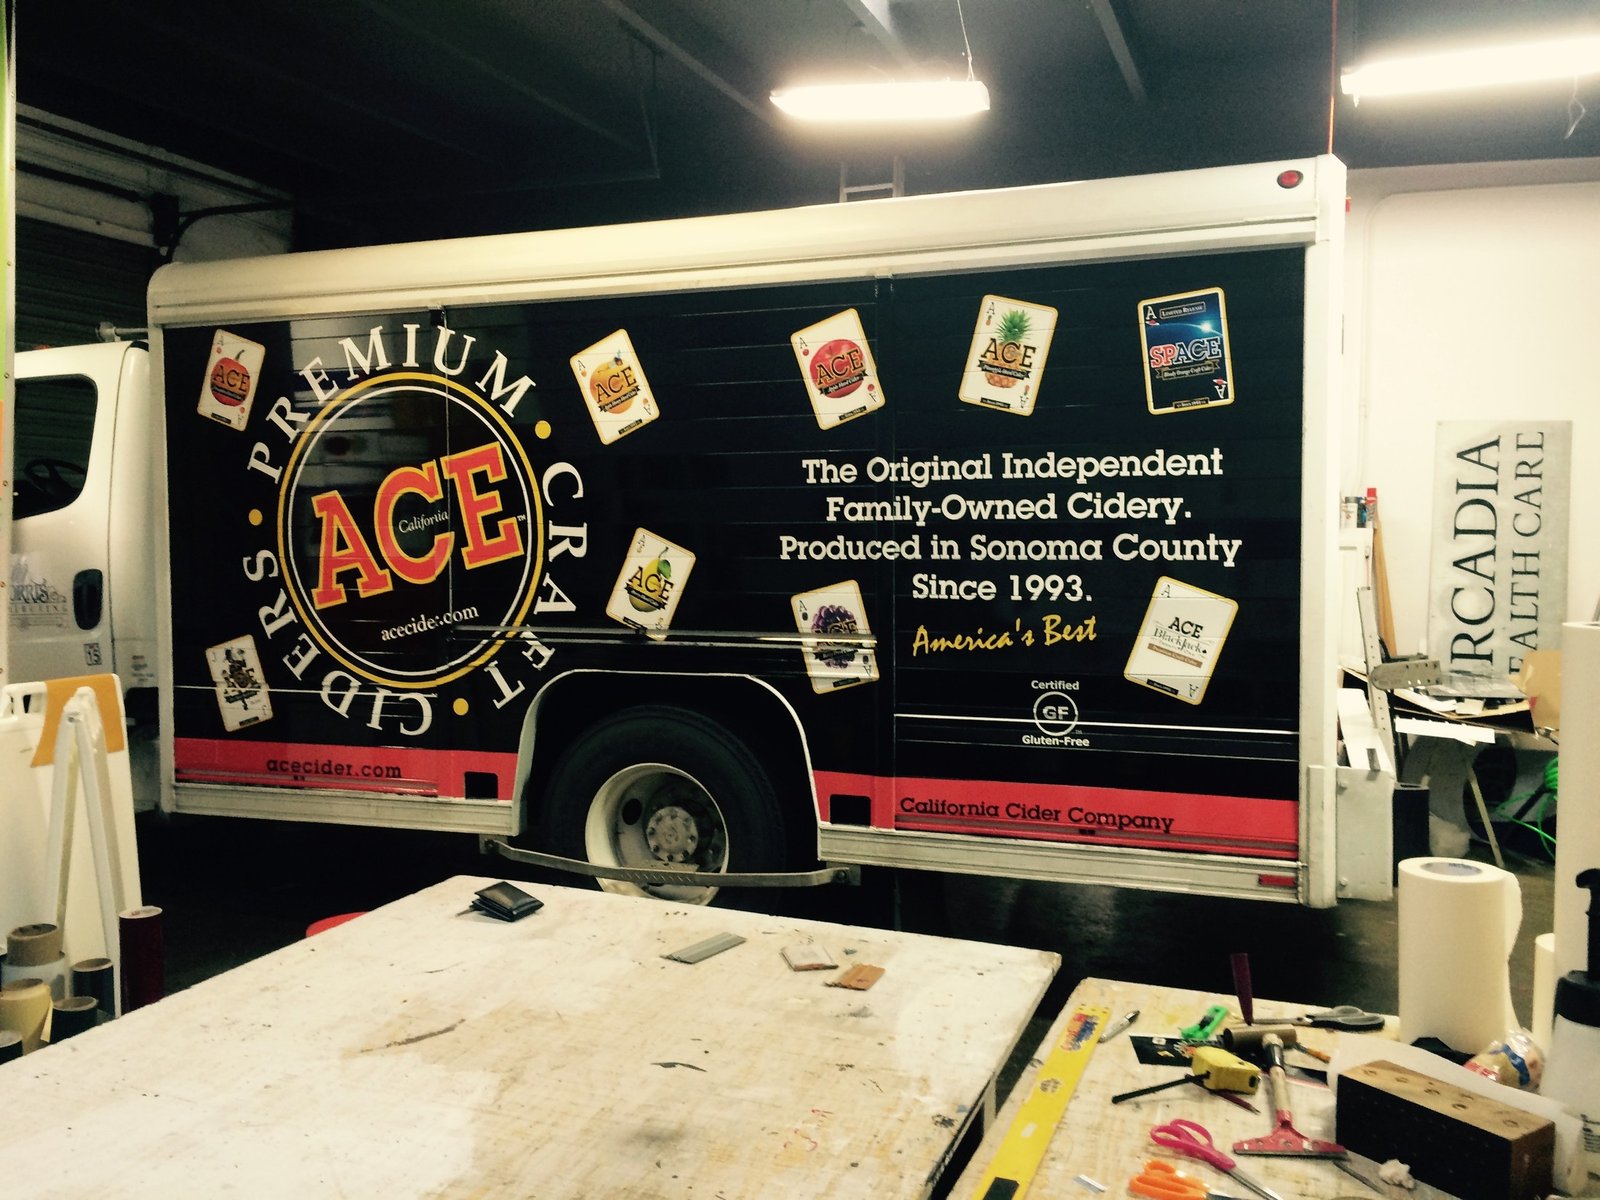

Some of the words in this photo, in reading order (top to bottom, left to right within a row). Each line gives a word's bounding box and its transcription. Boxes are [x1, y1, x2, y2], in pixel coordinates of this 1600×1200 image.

[1146, 306, 1157, 320] A
[817, 349, 864, 386] ACE
[980, 338, 1037, 369] ACE
[1150, 336, 1222, 368] SPACE
[212, 365, 250, 393] ACE
[596, 366, 637, 403] ACE
[247, 323, 537, 485] PREMIUM
[802, 459, 858, 484] The
[866, 453, 993, 488] Original
[1002, 447, 1223, 485] Independent
[1512, 431, 1545, 537] CARE
[311, 441, 524, 610] ACE
[826, 493, 1058, 526] Family-Owned
[1067, 491, 1191, 525] Cidery.
[779, 534, 922, 560] Produced
[930, 534, 961, 560] in
[970, 533, 1103, 560] Sonoma
[1112, 533, 1242, 568] County
[1449, 434, 1501, 679] RCADIA
[486, 461, 588, 710] CRAFT
[628, 566, 674, 602] ACE
[912, 573, 997, 600] Since
[1009, 574, 1093, 602] 1993.
[244, 549, 432, 737] CIDERS
[912, 617, 1035, 657] America's
[1041, 614, 1097, 646] Best
[1168, 617, 1204, 639] ACE
[1030, 680, 1080, 690] Certified
[1042, 705, 1069, 720] GF
[1022, 735, 1090, 747] Gluten-Free
[266, 759, 403, 779] acecider.com
[900, 797, 999, 817] California
[1005, 802, 1061, 822] Cider
[1067, 806, 1175, 834] Company
